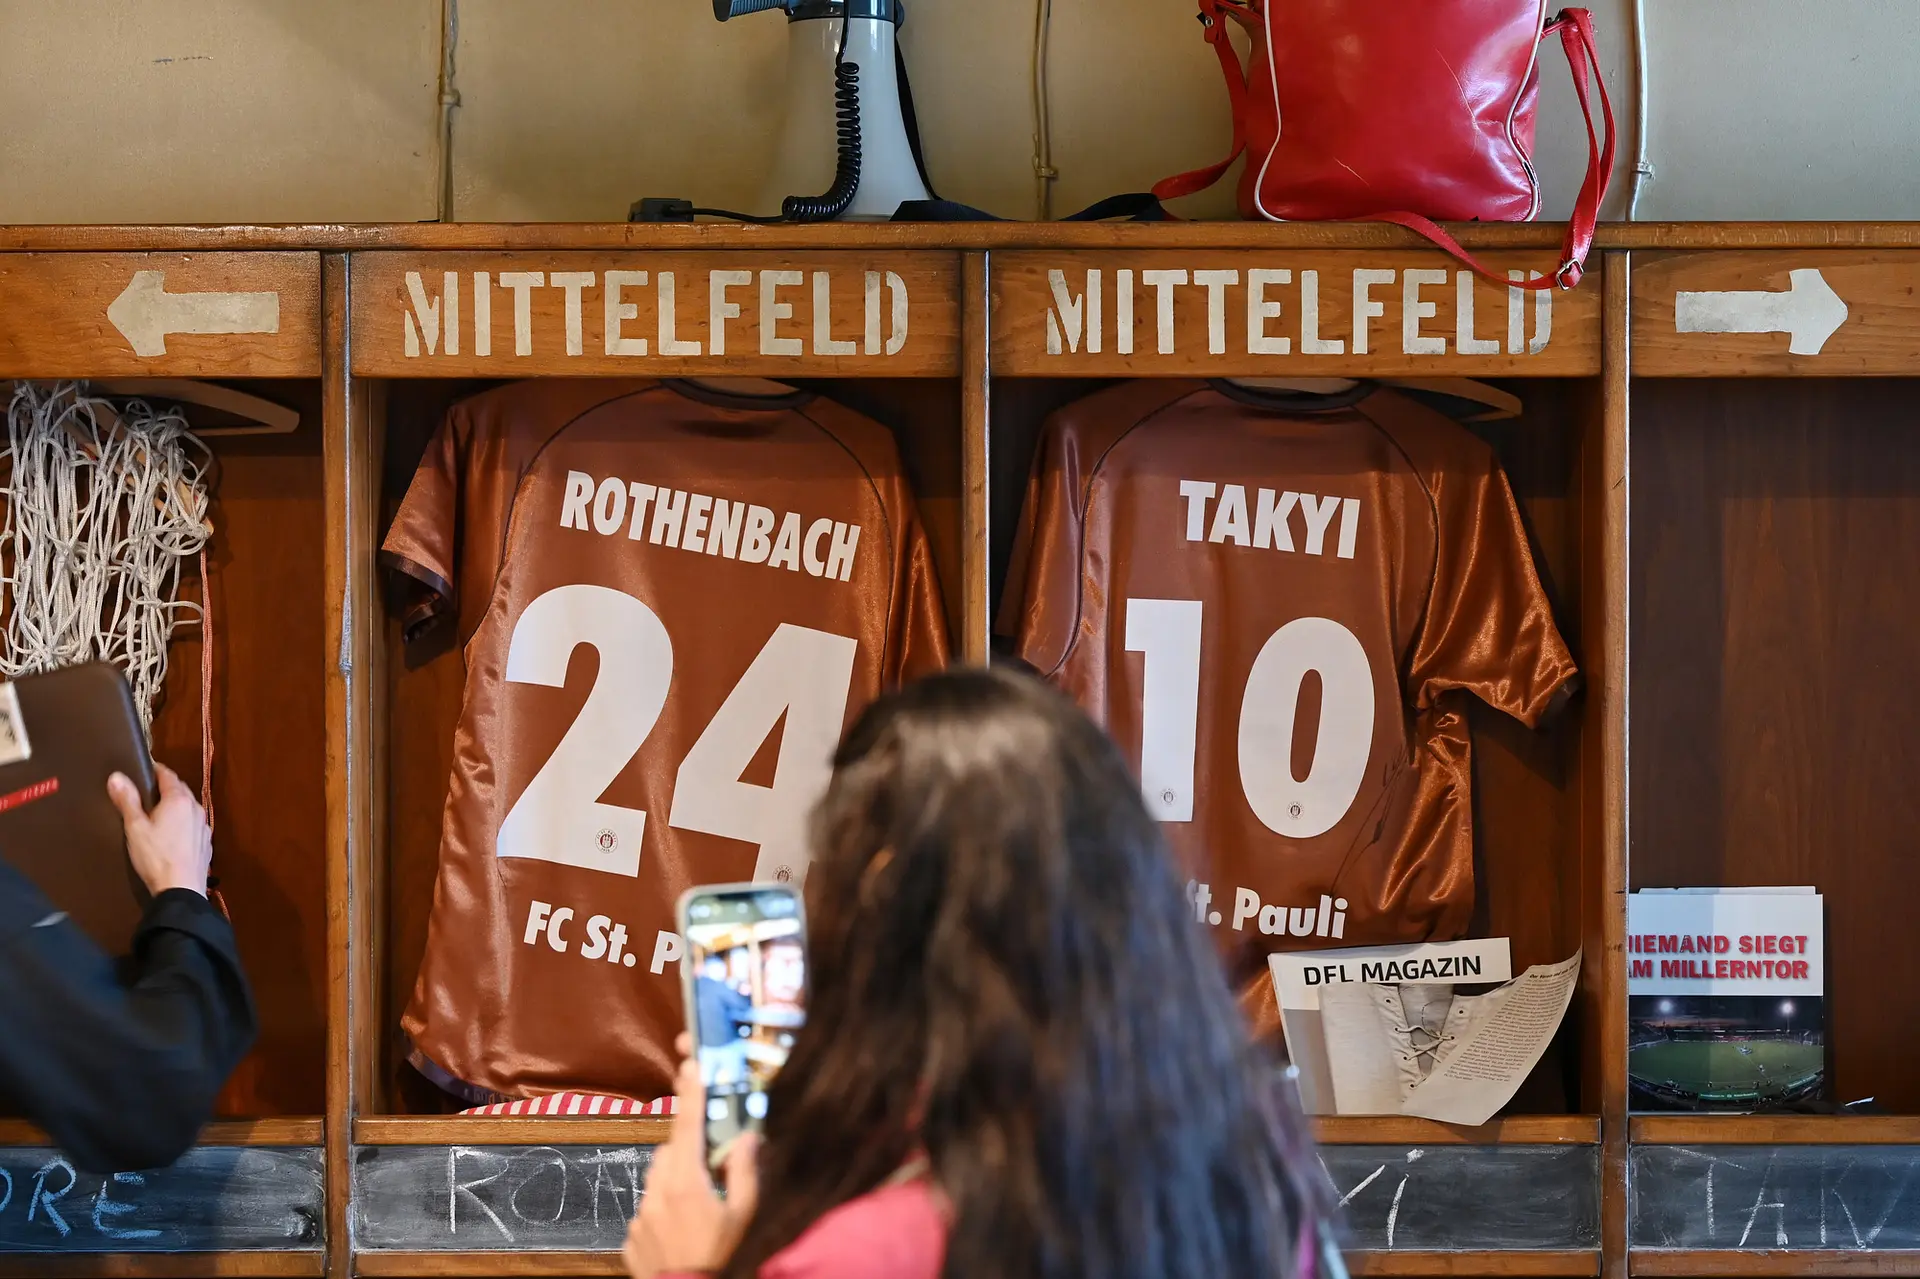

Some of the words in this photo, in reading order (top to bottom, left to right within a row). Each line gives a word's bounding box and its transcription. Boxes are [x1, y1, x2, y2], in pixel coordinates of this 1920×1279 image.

[404, 270, 908, 357] MITTELFELD
[1047, 268, 1552, 355] MITTELFELD
[559, 470, 861, 582] ROTHENBACH
[1179, 479, 1361, 560] TAKYI
[497, 584, 858, 885] 24
[1125, 598, 1375, 838] 10
[524, 900, 574, 953] FC
[581, 914, 637, 968] St.
[1232, 886, 1348, 940] Pauli
[1738, 934, 1808, 955] SIEGT
[1303, 964, 1353, 985] DFL
[1361, 955, 1482, 982] MAGAZIN
[1628, 960, 1653, 978] M
[1661, 960, 1808, 979] MILLERNTOR
